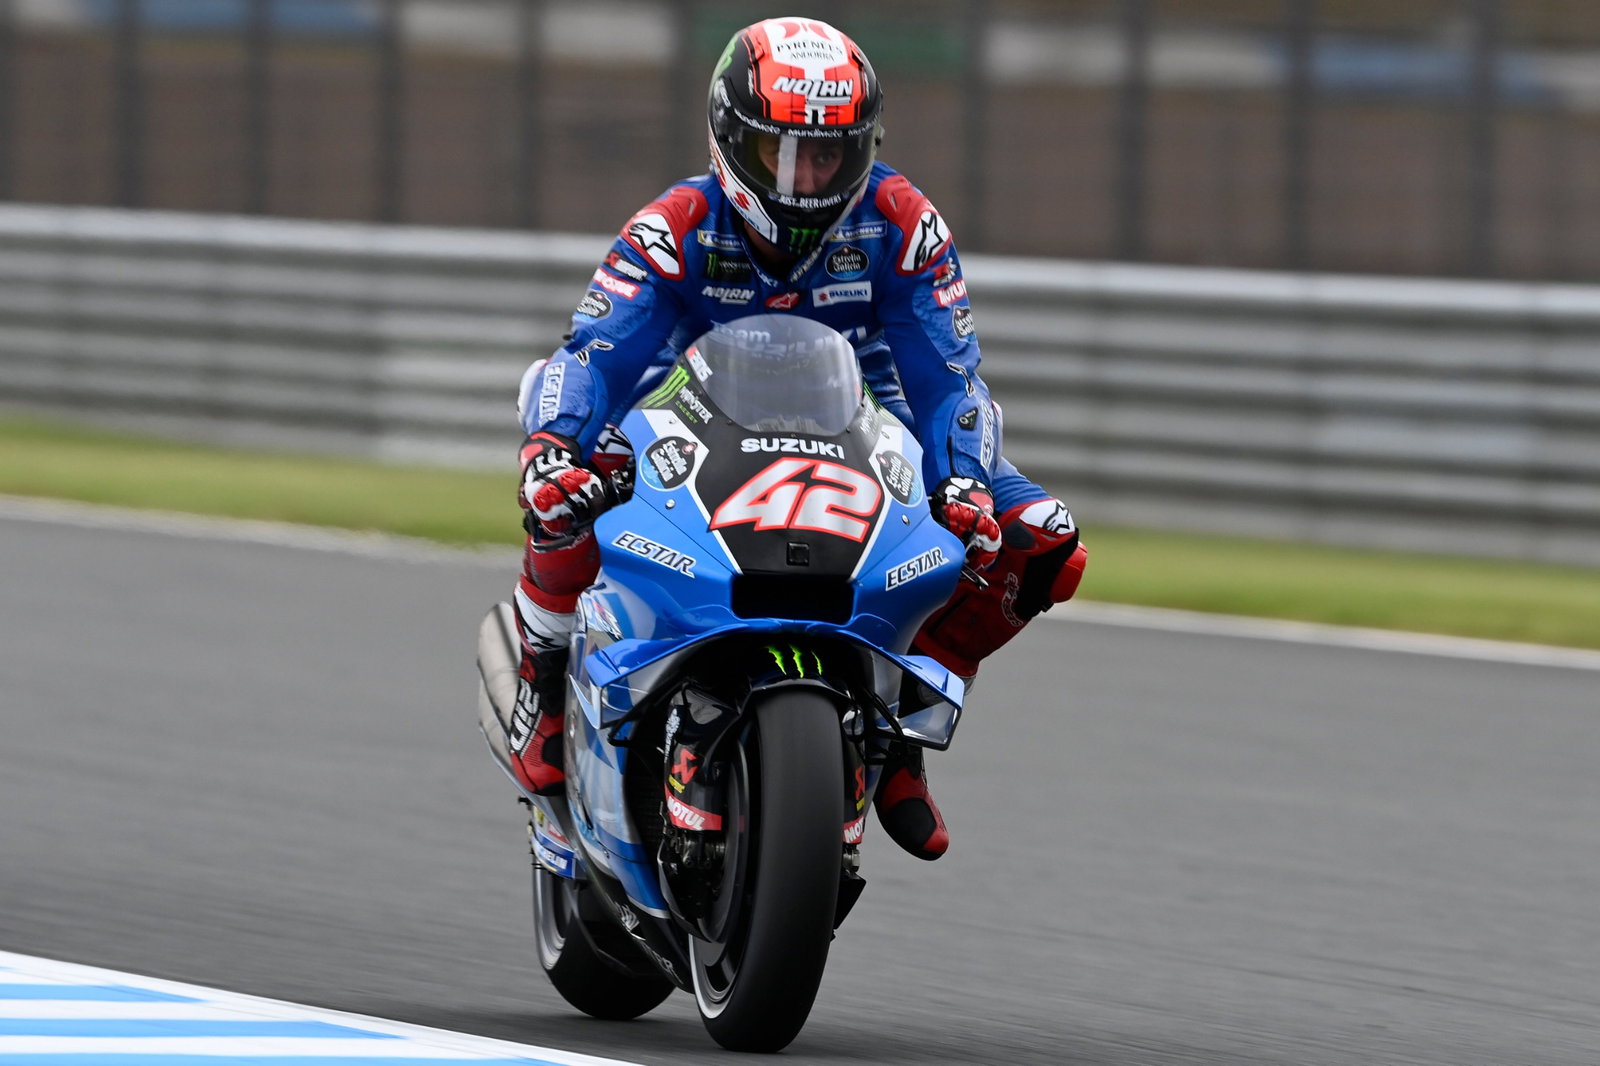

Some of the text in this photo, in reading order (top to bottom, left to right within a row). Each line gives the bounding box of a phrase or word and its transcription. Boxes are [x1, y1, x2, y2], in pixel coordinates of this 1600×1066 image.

[791, 50, 835, 61] ANDORRA
[772, 76, 854, 106] NOLAN
[702, 286, 755, 305] NOLAN
[829, 289, 867, 298] SUZUKI
[539, 361, 566, 428] ECSTAR
[740, 437, 845, 460] SUZUKI
[886, 455, 902, 488] Estrella
[898, 466, 913, 497] Galicia
[709, 456, 883, 543] 42
[612, 530, 697, 579] ECSTAR
[886, 547, 949, 592] ECSTAR
[667, 796, 706, 831] MOTUL
